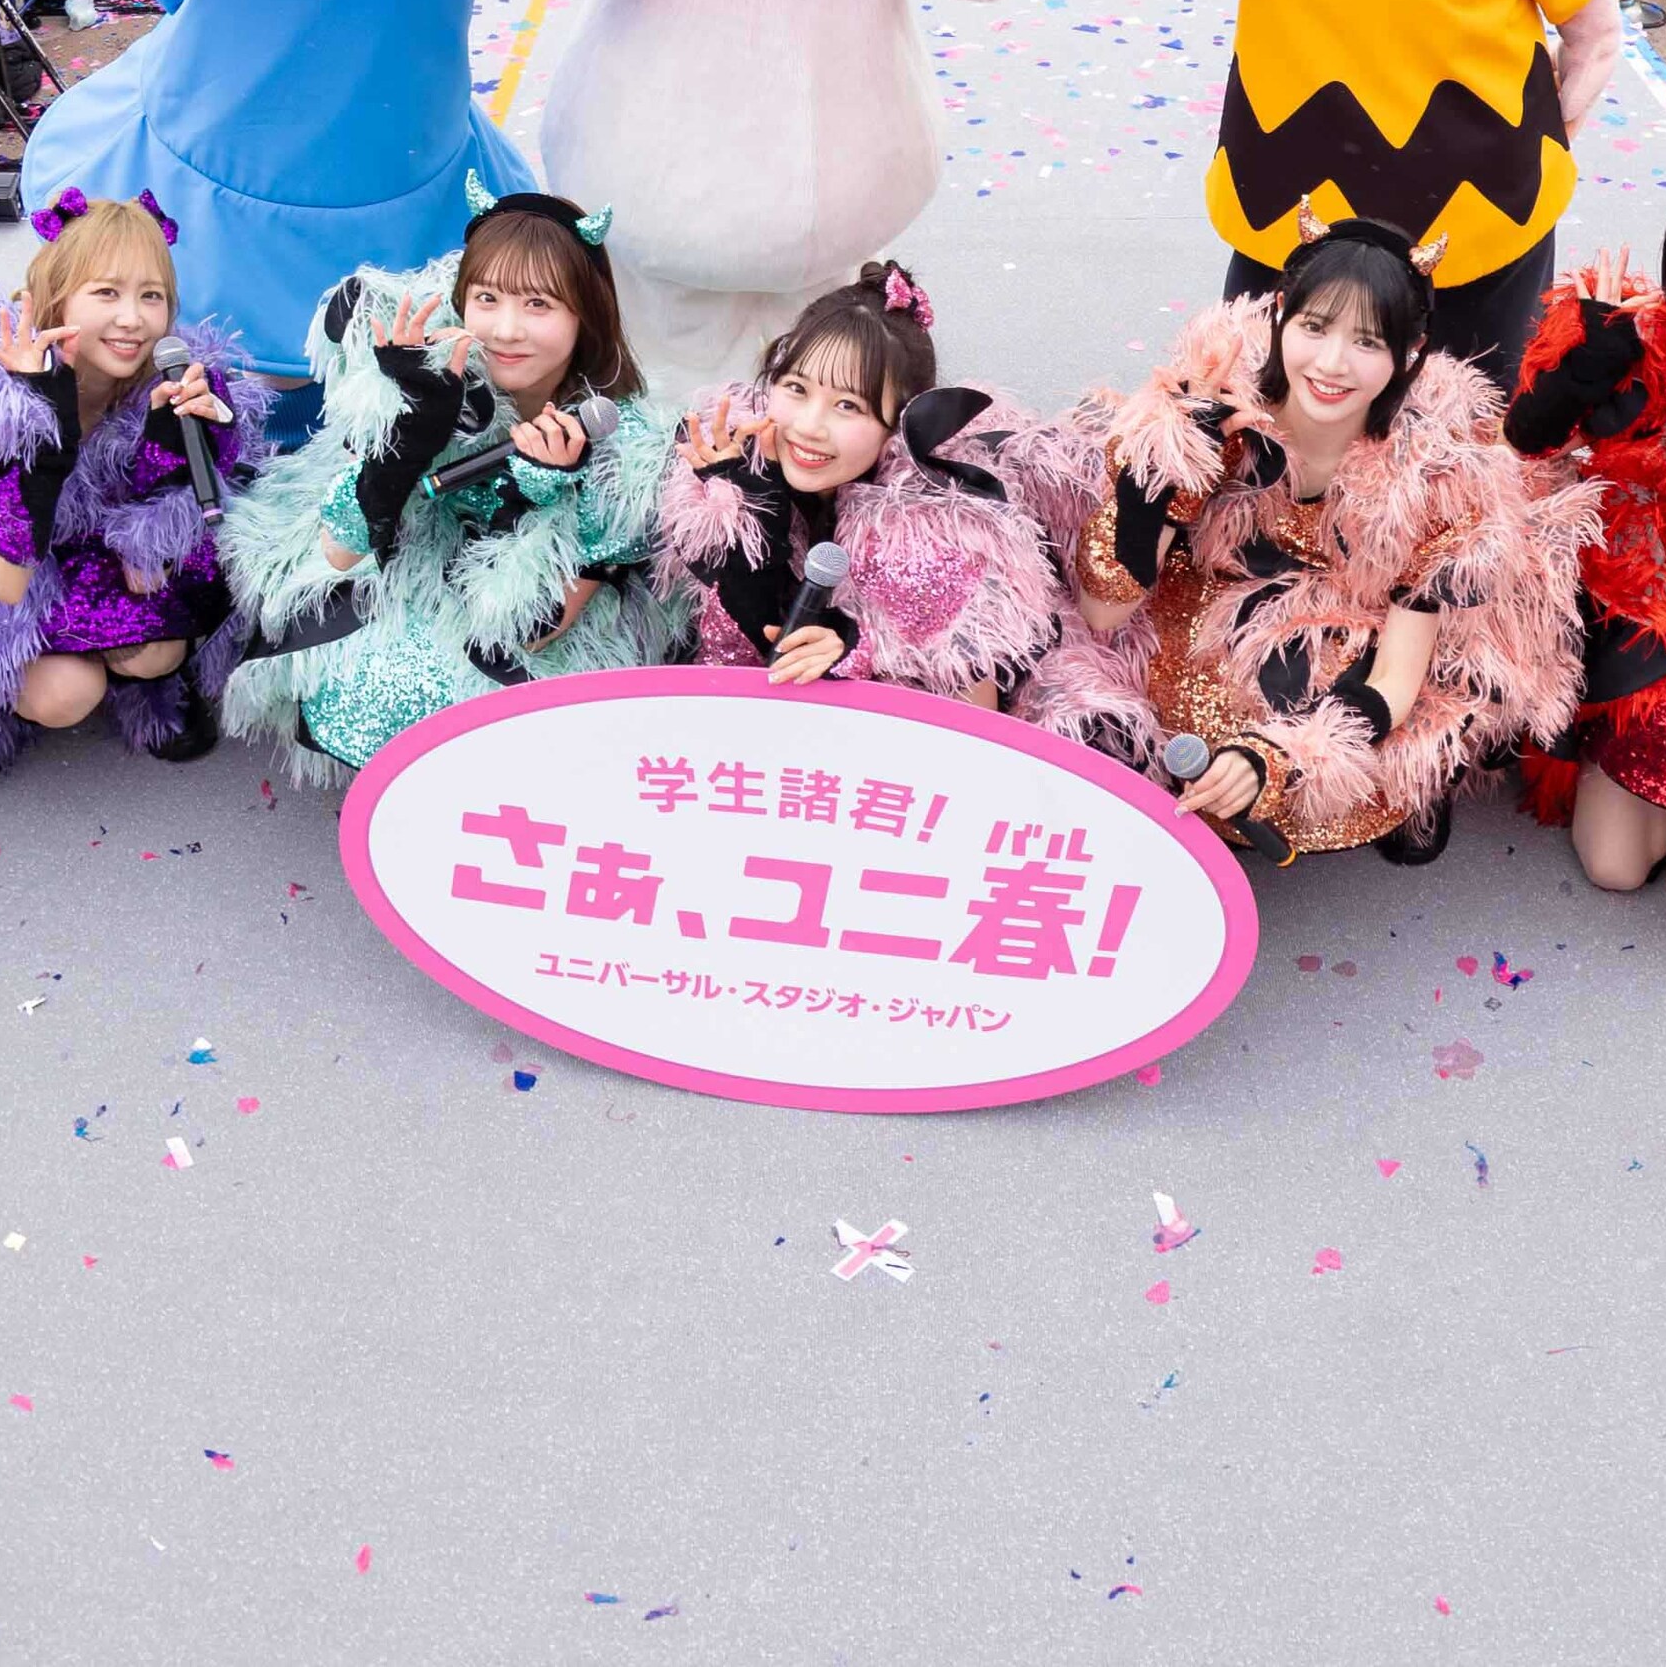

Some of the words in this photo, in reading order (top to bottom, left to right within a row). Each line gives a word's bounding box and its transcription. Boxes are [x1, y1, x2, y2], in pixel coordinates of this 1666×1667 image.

[636, 755, 947, 842] 学生諸君!
[987, 821, 1092, 861] バル
[535, 952, 1011, 1034] ユニバーサル・スタジオ・ジャパン
